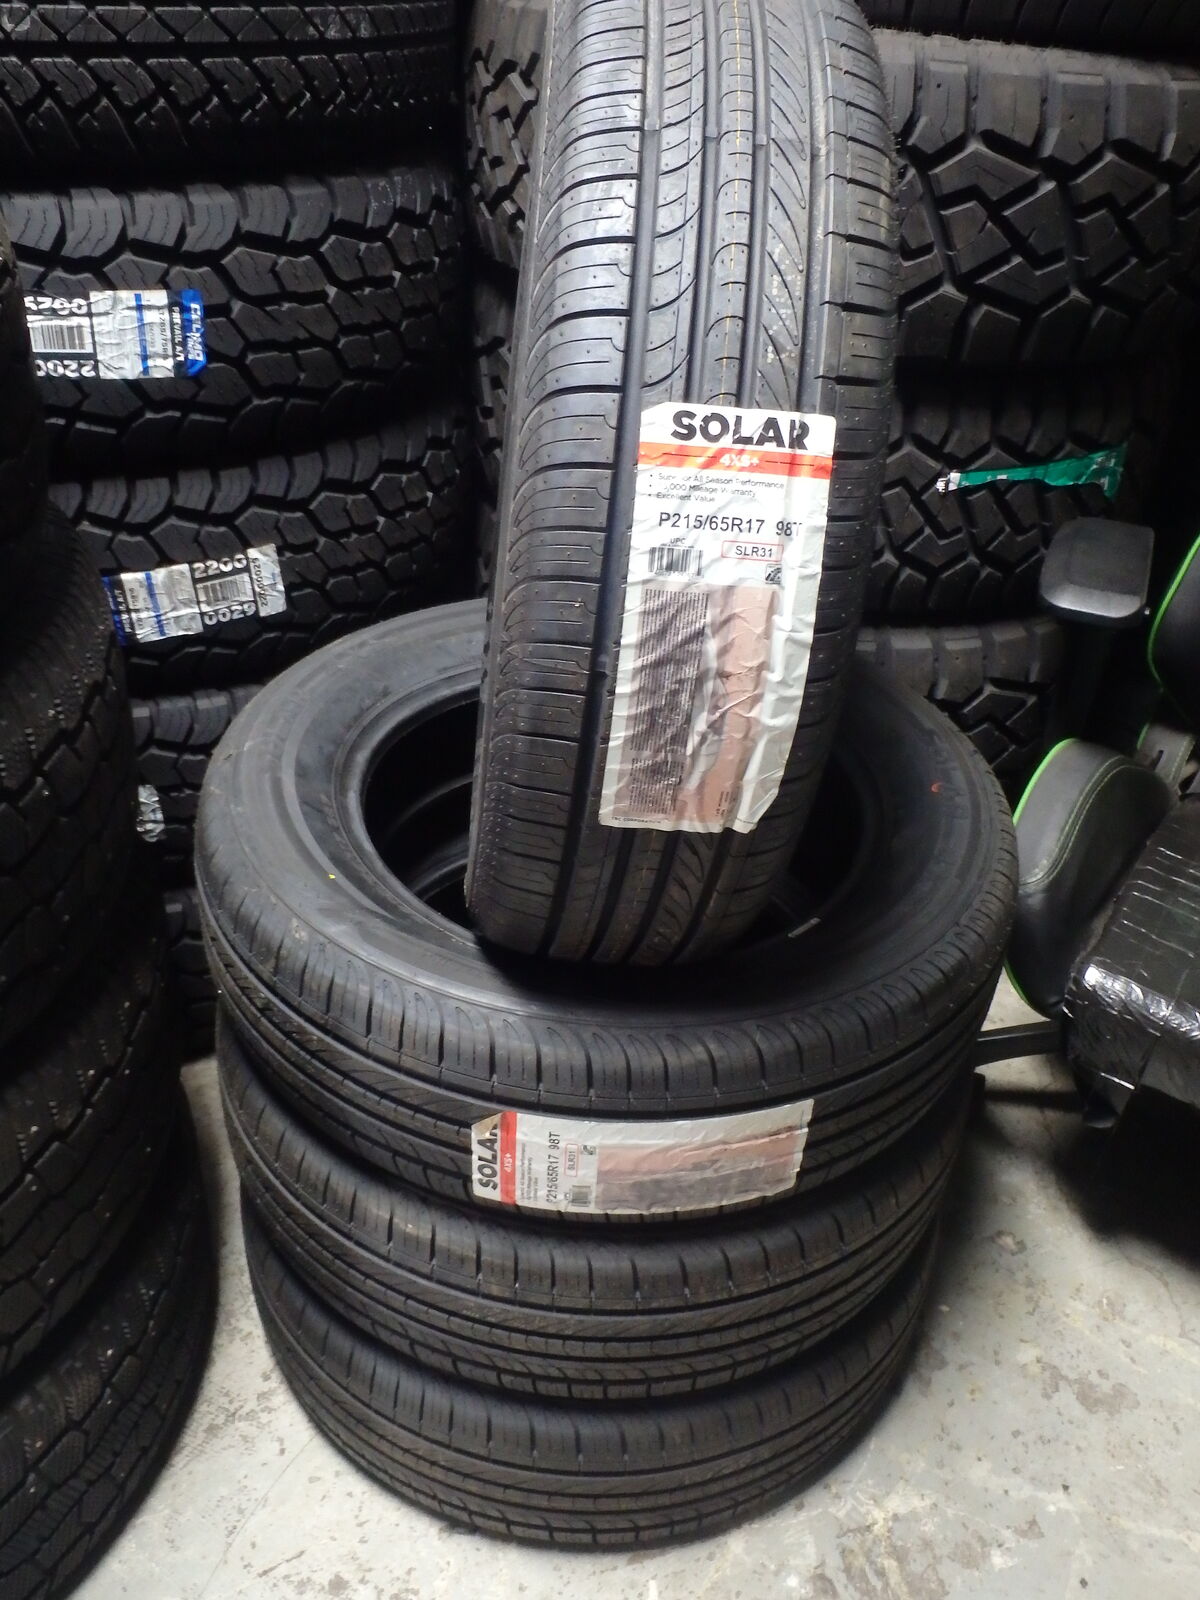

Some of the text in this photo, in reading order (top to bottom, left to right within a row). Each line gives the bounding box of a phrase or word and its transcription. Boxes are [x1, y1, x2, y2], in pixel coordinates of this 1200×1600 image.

[171, 306, 182, 343] PREVAIL
[670, 410, 810, 450] SOLAR
[658, 511, 766, 535] P215/65R17
[734, 545, 774, 558] SLR31
[192, 554, 248, 579] 2200
[548, 1131, 561, 1150] 98T
